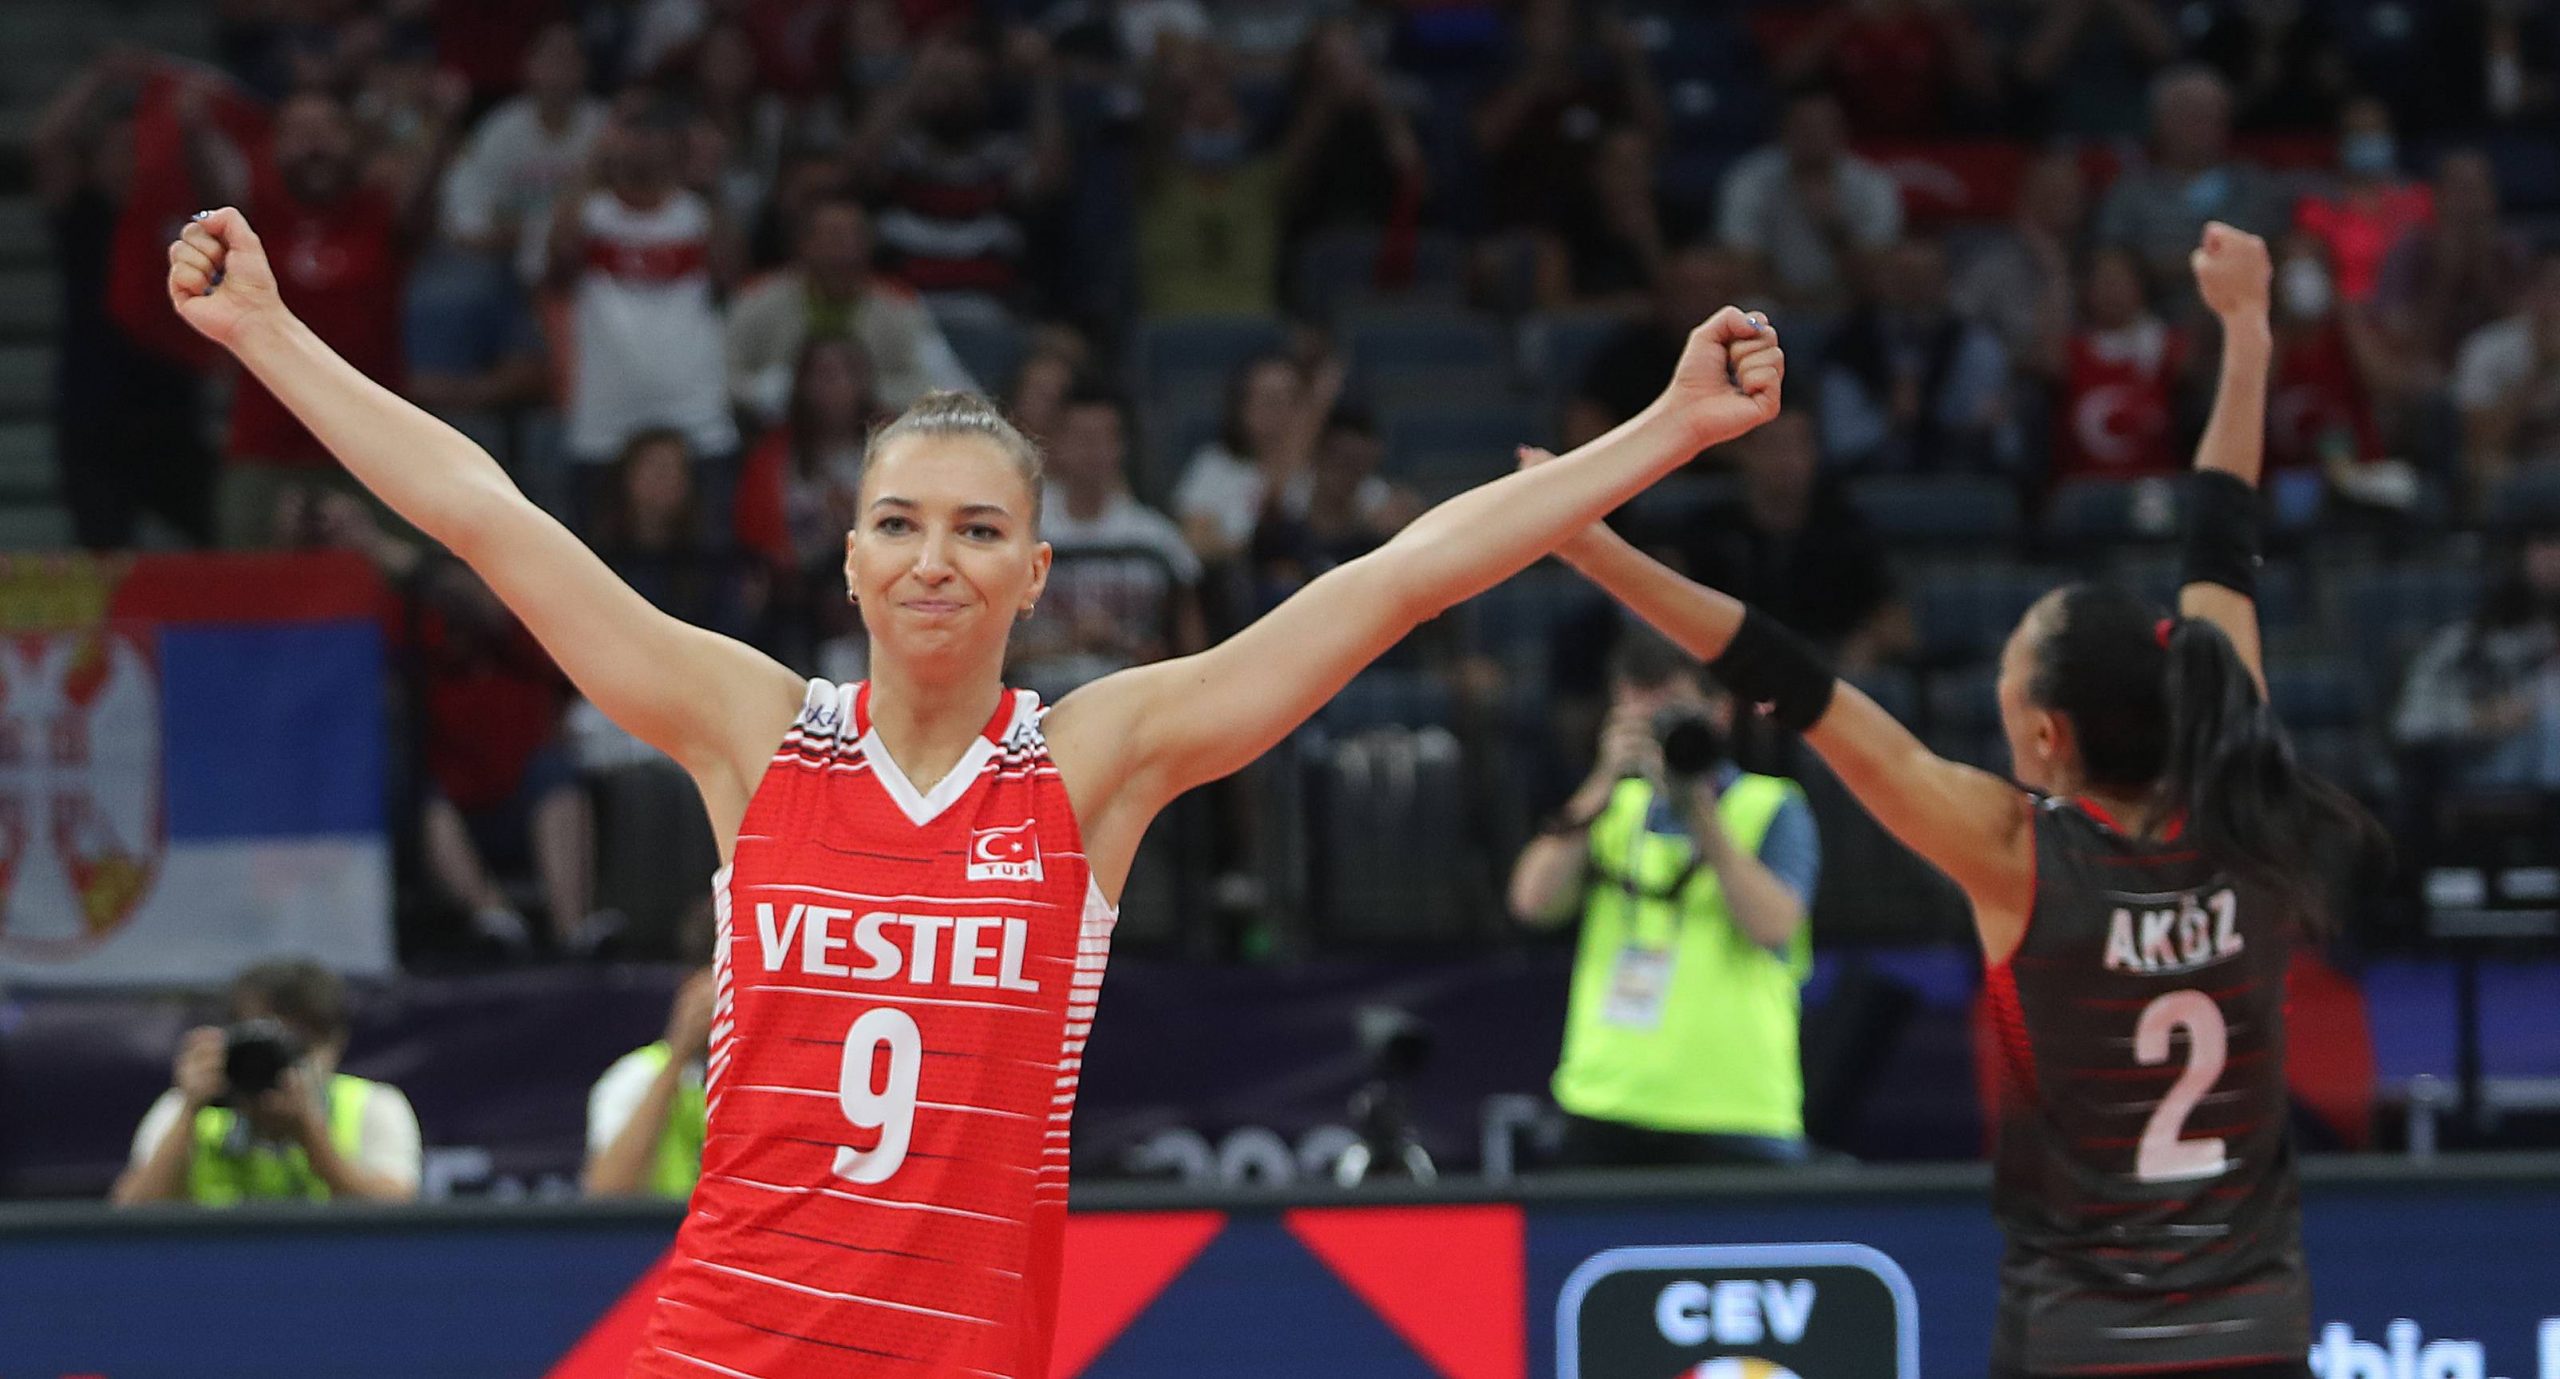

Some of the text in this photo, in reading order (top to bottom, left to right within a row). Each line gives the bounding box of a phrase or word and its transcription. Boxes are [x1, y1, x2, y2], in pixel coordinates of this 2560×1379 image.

[986, 864, 1029, 876] TUR
[755, 902, 1041, 993] VESTEL
[2102, 888, 2245, 974] AKÖZ
[832, 1006, 923, 1185] 9
[2133, 988, 2228, 1183] 2
[1654, 1279, 1817, 1346] CEV
